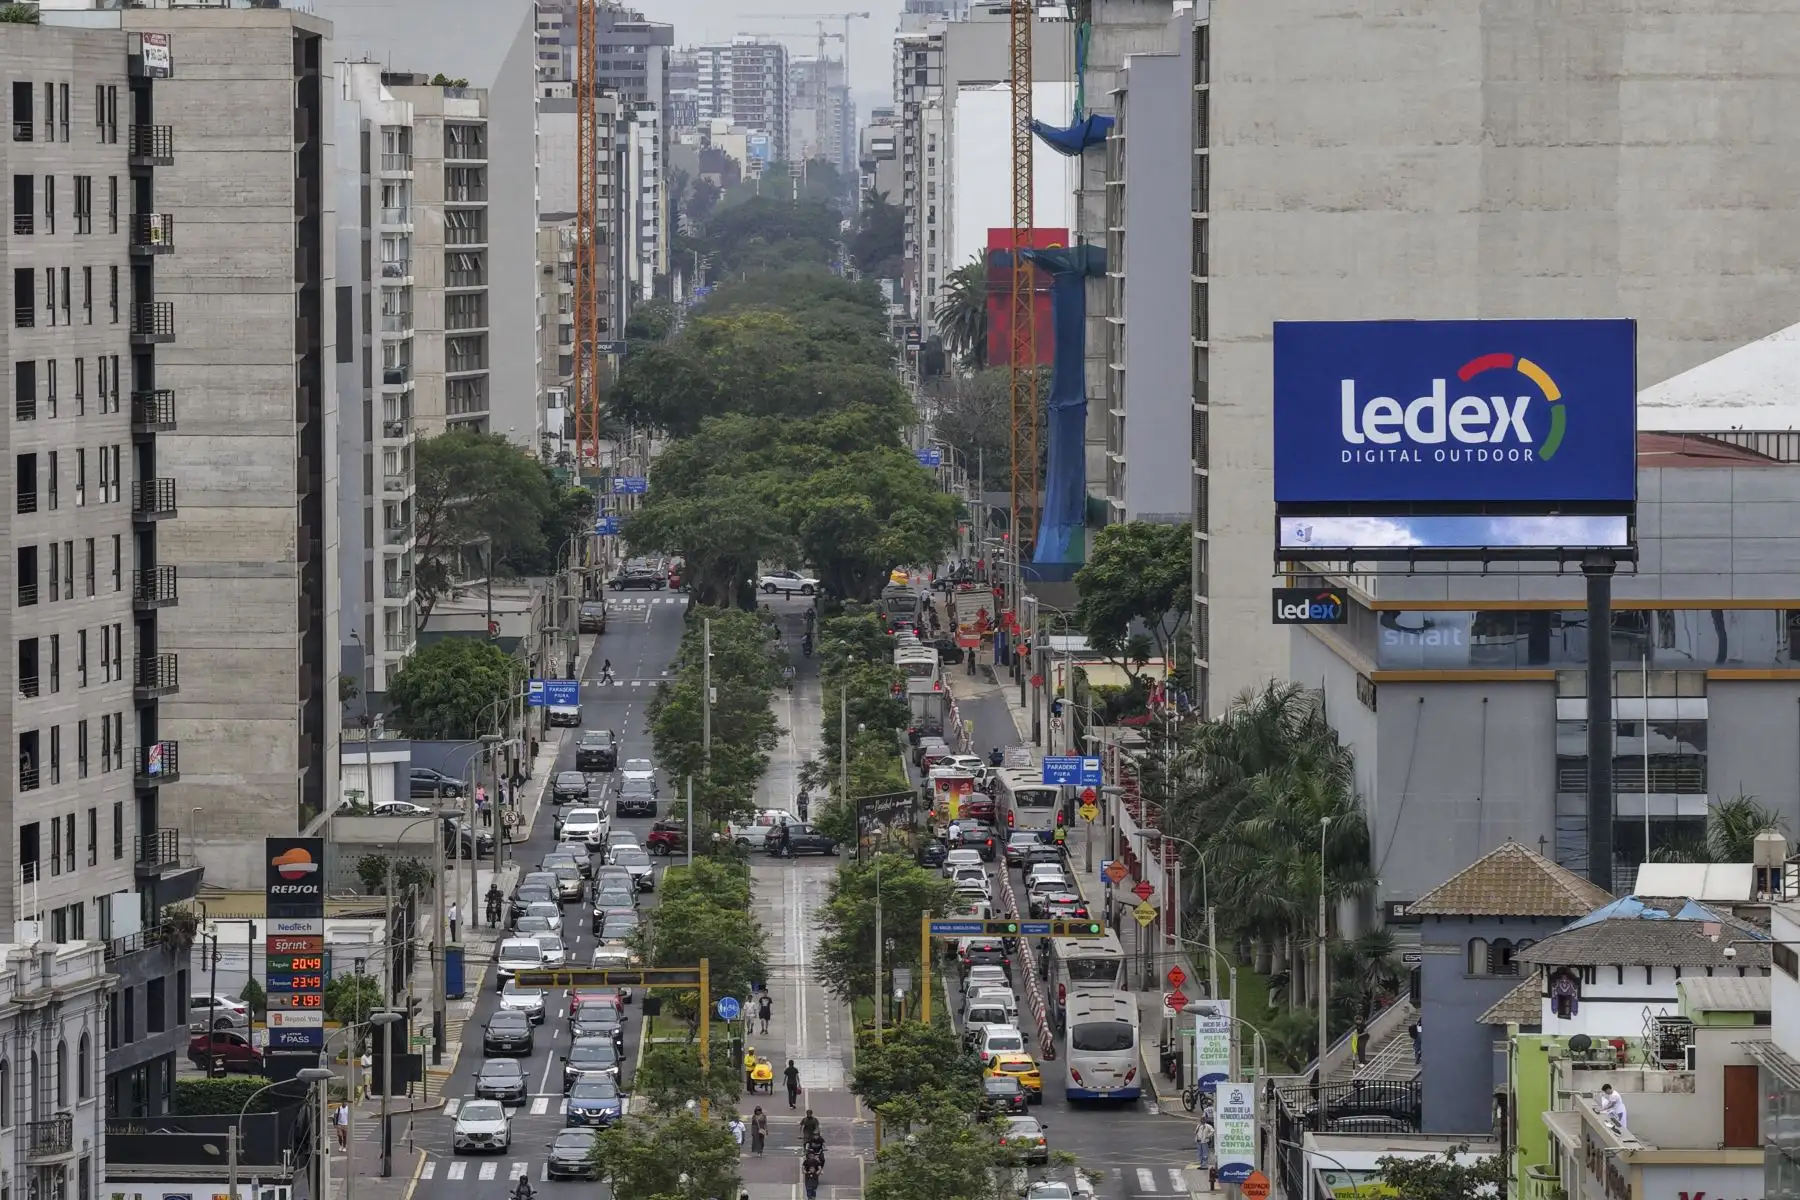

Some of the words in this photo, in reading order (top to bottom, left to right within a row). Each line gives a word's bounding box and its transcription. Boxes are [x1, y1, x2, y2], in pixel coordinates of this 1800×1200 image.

[1341, 378, 1534, 444] ledex
[1341, 449, 1422, 463] DIGITAL
[1434, 448, 1534, 463] OUTDOOR
[1277, 598, 1336, 620] ledex
[1384, 627, 1463, 647] smart
[271, 884, 319, 894] REPSOL
[277, 922, 312, 931] NeoTech
[275, 941, 307, 952] sprint
[292, 958, 321, 969] 20.49
[292, 977, 321, 988] 23.49
[292, 995, 321, 1006] 21.99
[1220, 1141, 1254, 1149] CENTRAL
